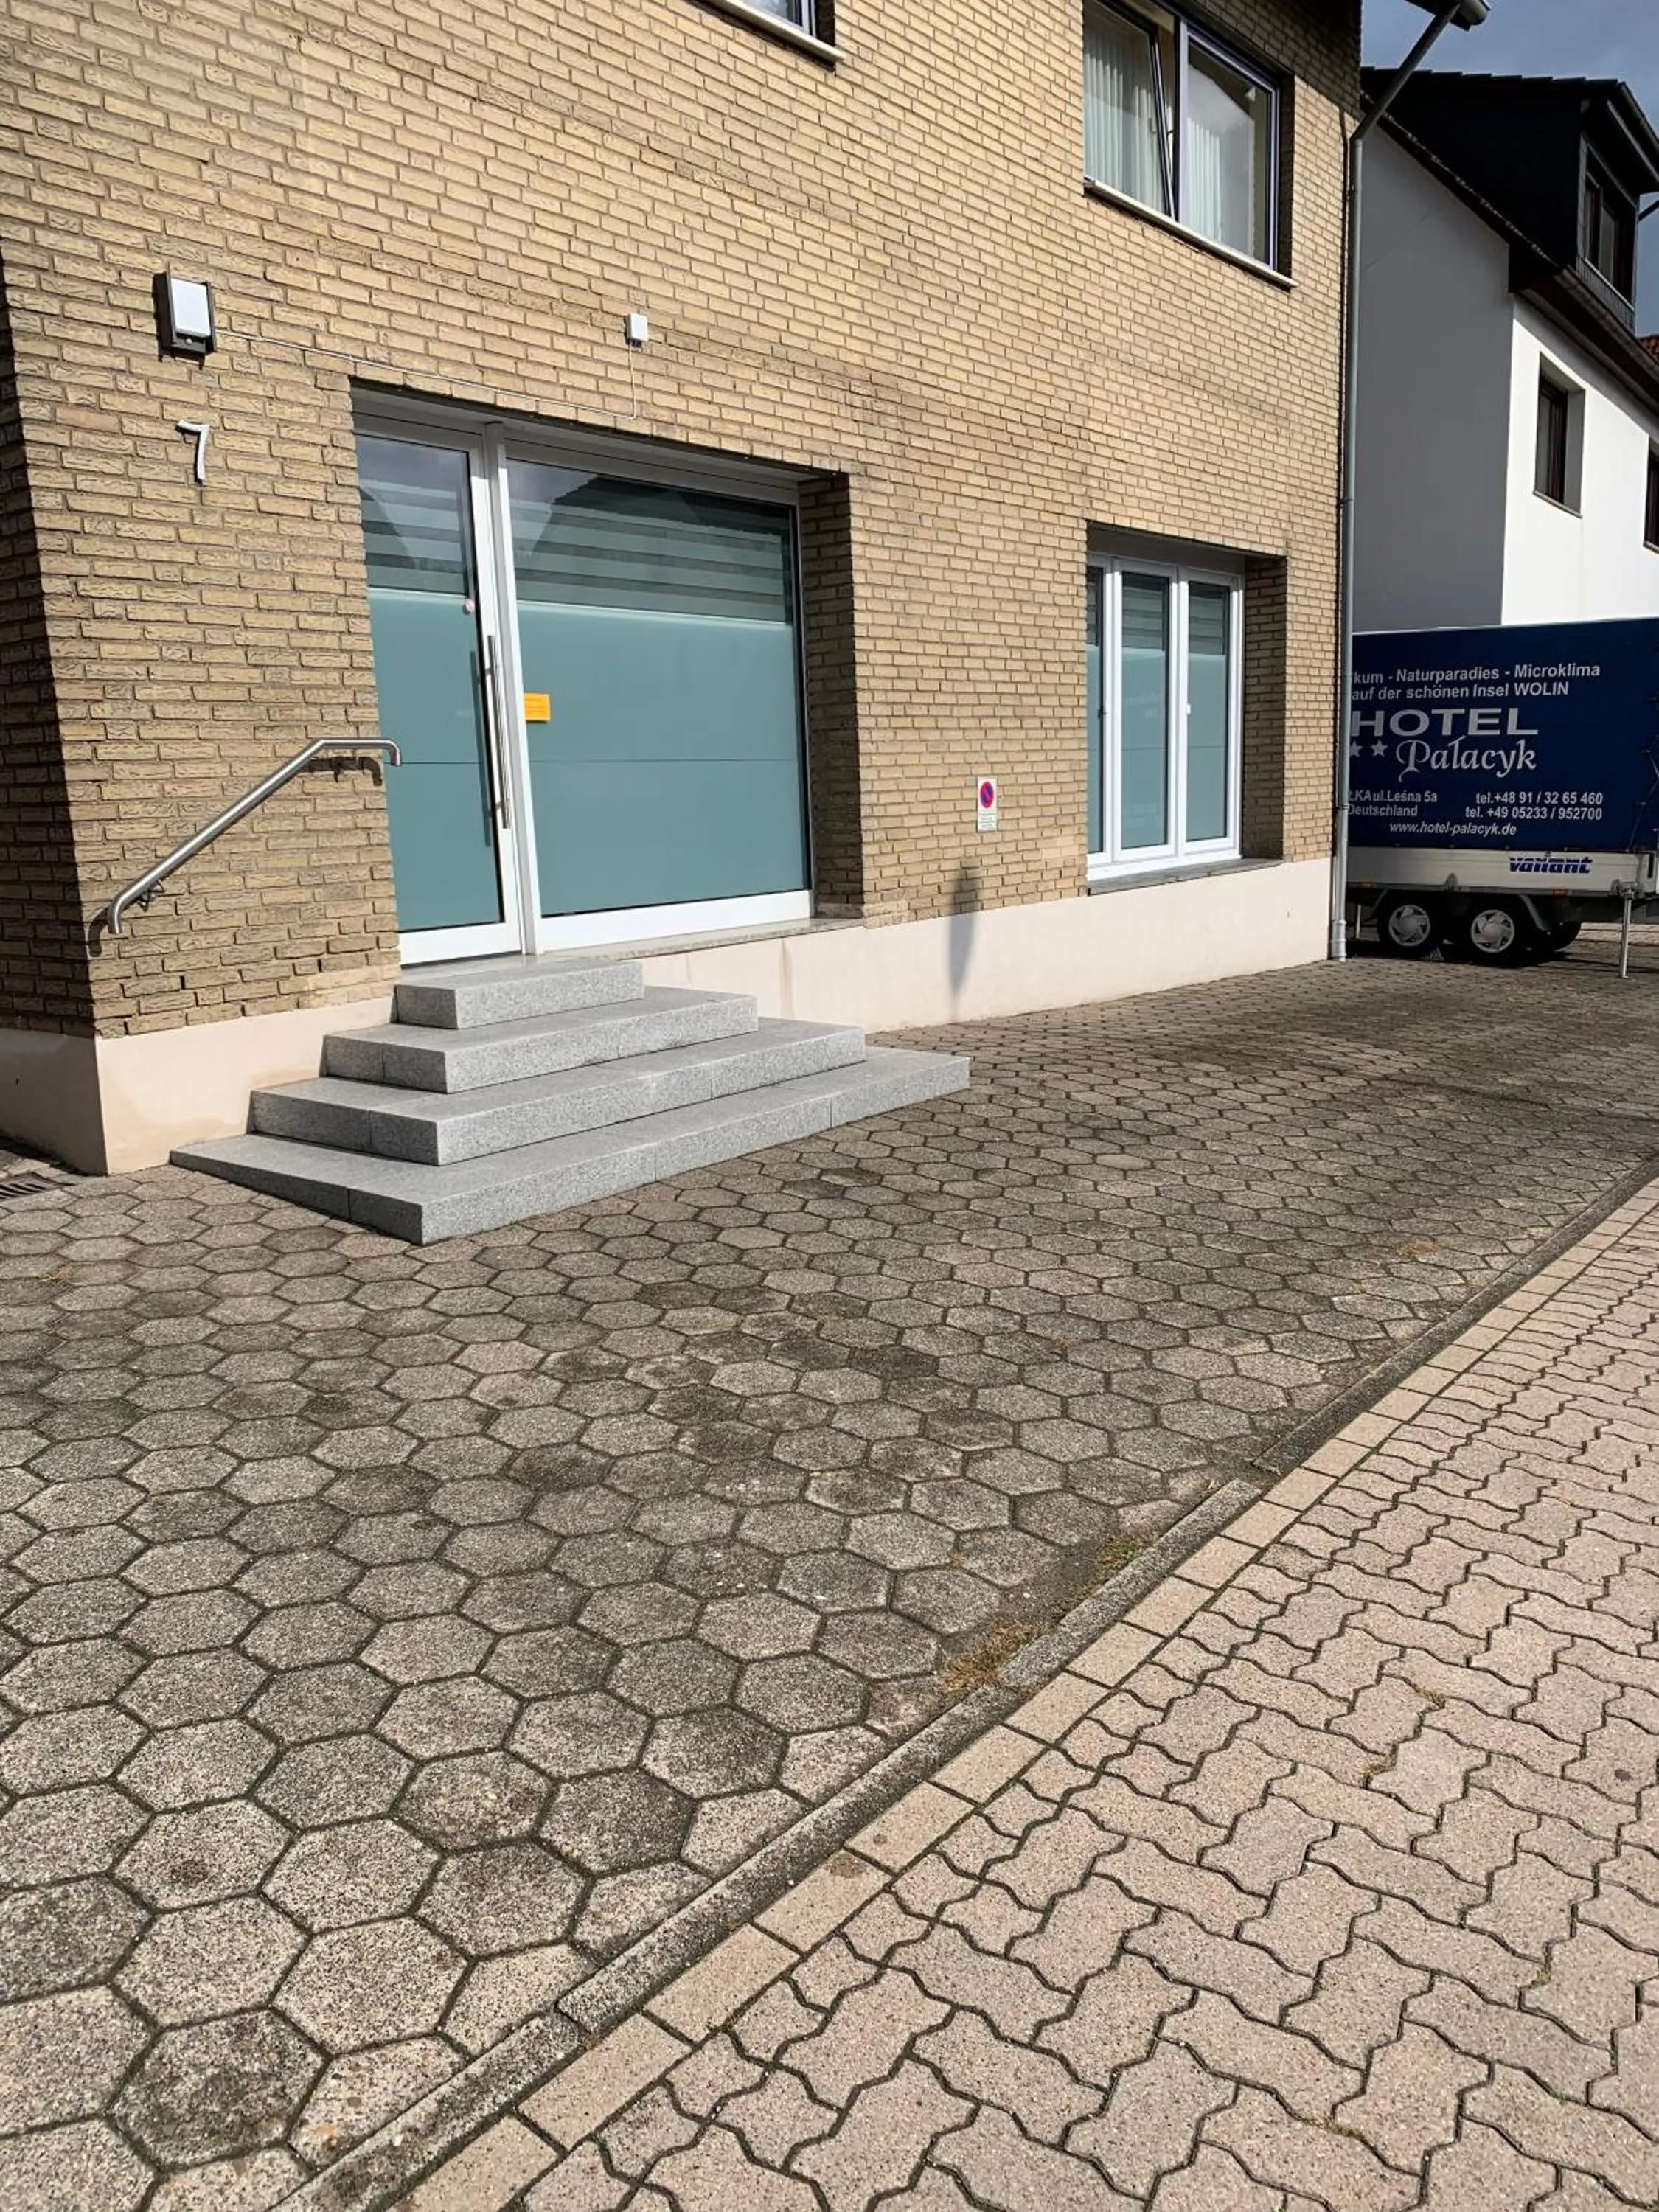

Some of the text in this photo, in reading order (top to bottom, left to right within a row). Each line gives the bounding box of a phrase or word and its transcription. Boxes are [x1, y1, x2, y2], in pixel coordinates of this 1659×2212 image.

[175, 418, 209, 480] 7
[1396, 666, 1500, 684] Naturparadies
[1514, 662, 1601, 678] Microklima
[1352, 681, 1569, 700] auf der schönen Insel WOLIN
[1351, 707, 1539, 737] HOTEL
[1423, 790, 1438, 803] 5a
[1518, 792, 1533, 804] 91
[1544, 792, 1559, 804] 32
[1562, 792, 1577, 804] 65
[1580, 792, 1604, 805] 460
[1349, 803, 1418, 817] Deutschland
[1465, 807, 1484, 818] tel.
[1487, 807, 1509, 818] +49
[1512, 807, 1548, 819] 05233
[1558, 807, 1603, 820] 952700
[1390, 821, 1517, 838] www.hotel-palacyk.de
